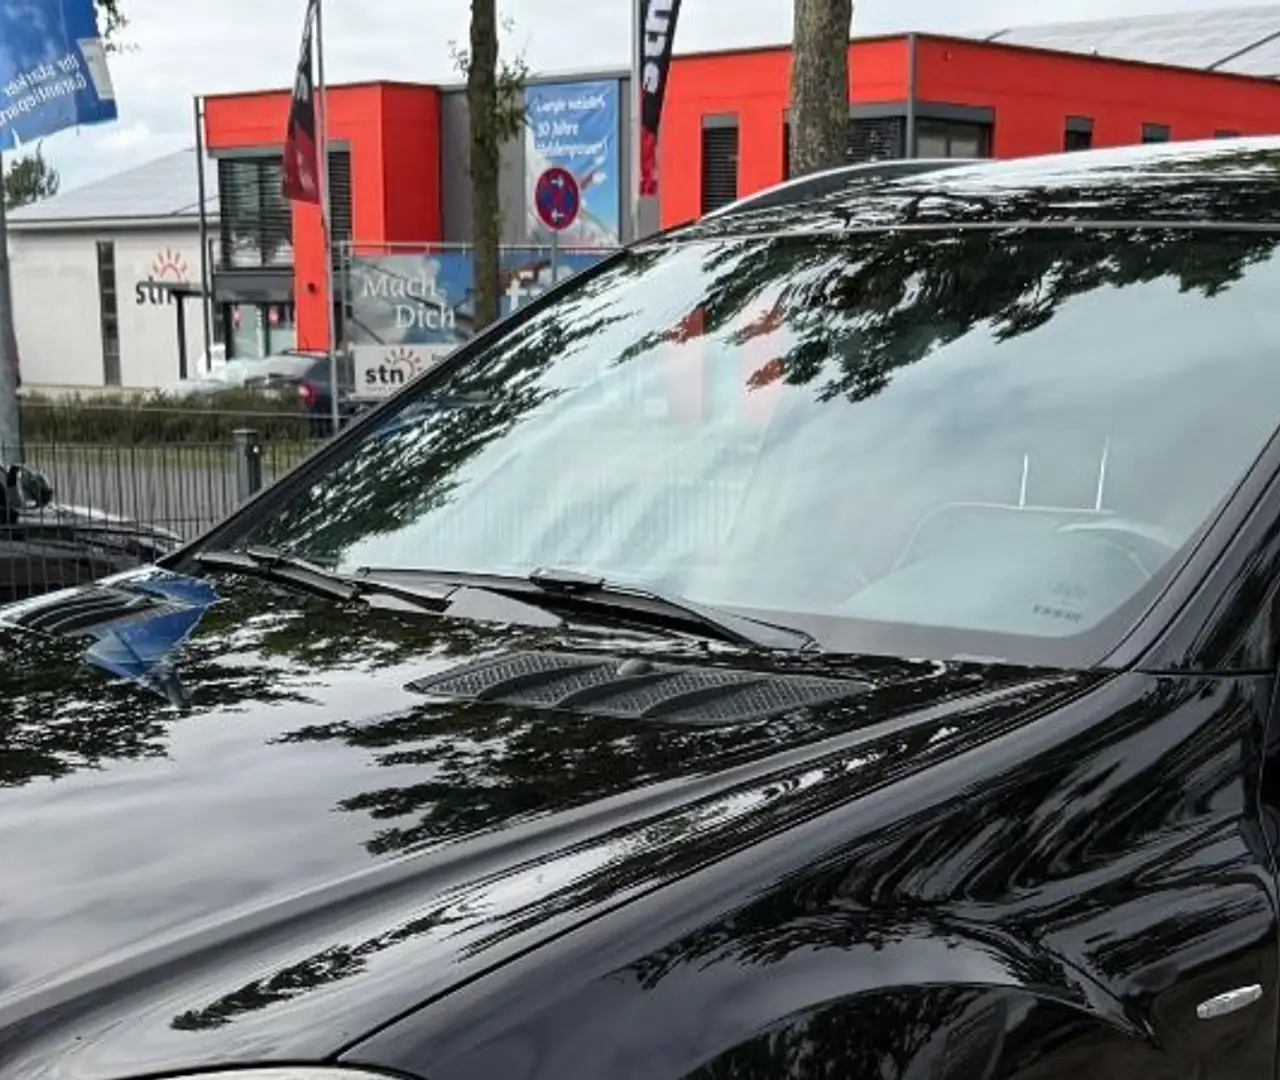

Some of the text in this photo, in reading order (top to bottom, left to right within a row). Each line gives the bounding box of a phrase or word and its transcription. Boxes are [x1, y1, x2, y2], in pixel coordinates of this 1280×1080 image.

[362, 274, 438, 298] Mach
[395, 304, 456, 330] Dich
[365, 367, 405, 385] stn
